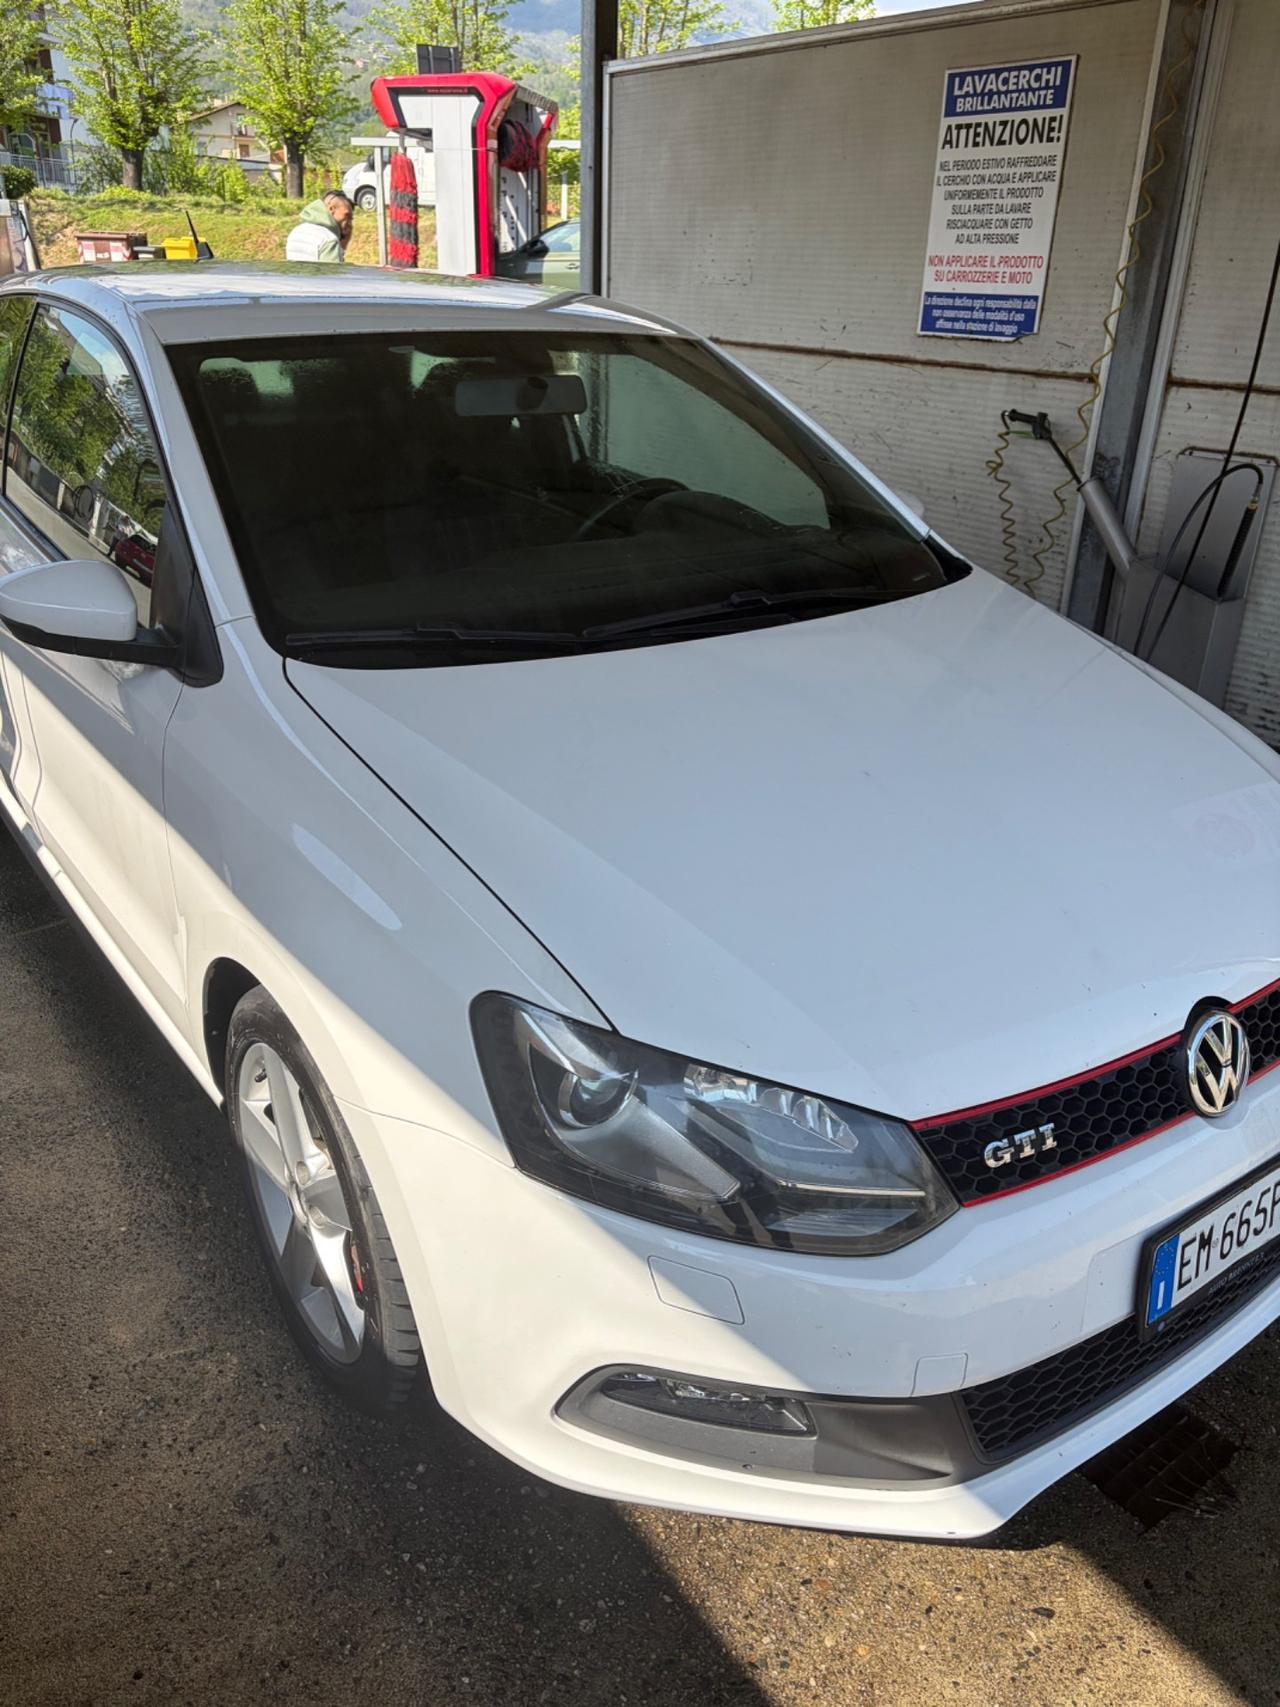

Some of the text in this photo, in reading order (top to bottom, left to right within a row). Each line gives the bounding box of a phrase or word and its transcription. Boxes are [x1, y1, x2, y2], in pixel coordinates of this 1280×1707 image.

[954, 66, 1062, 95] LAVACERCHI
[956, 89, 1054, 112] BRILLANTANTE
[941, 114, 1064, 149] ATTENZIONE!
[939, 155, 1058, 171] NEL PERIODO ESTIVO RAFFREDDARE
[936, 170, 1057, 186] IL CERCHIO CON ACQUA E APPLICARE
[944, 186, 1044, 200] UNIFORMEMENTE IL PRODOTTO
[951, 202, 1032, 215] SULLA PARTE DA LAVARE
[946, 217, 1033, 230] RISCIACQUARE CON GETTO
[955, 232, 1020, 244] AD ALTA PRESSIONE
[928, 255, 1044, 269] NON APPLICARE IL PRODOTTO
[934, 270, 1033, 284] SU CARROZZERIE E MOTO
[954, 296, 973, 306] declina
[983, 1122, 1057, 1169] GTI
